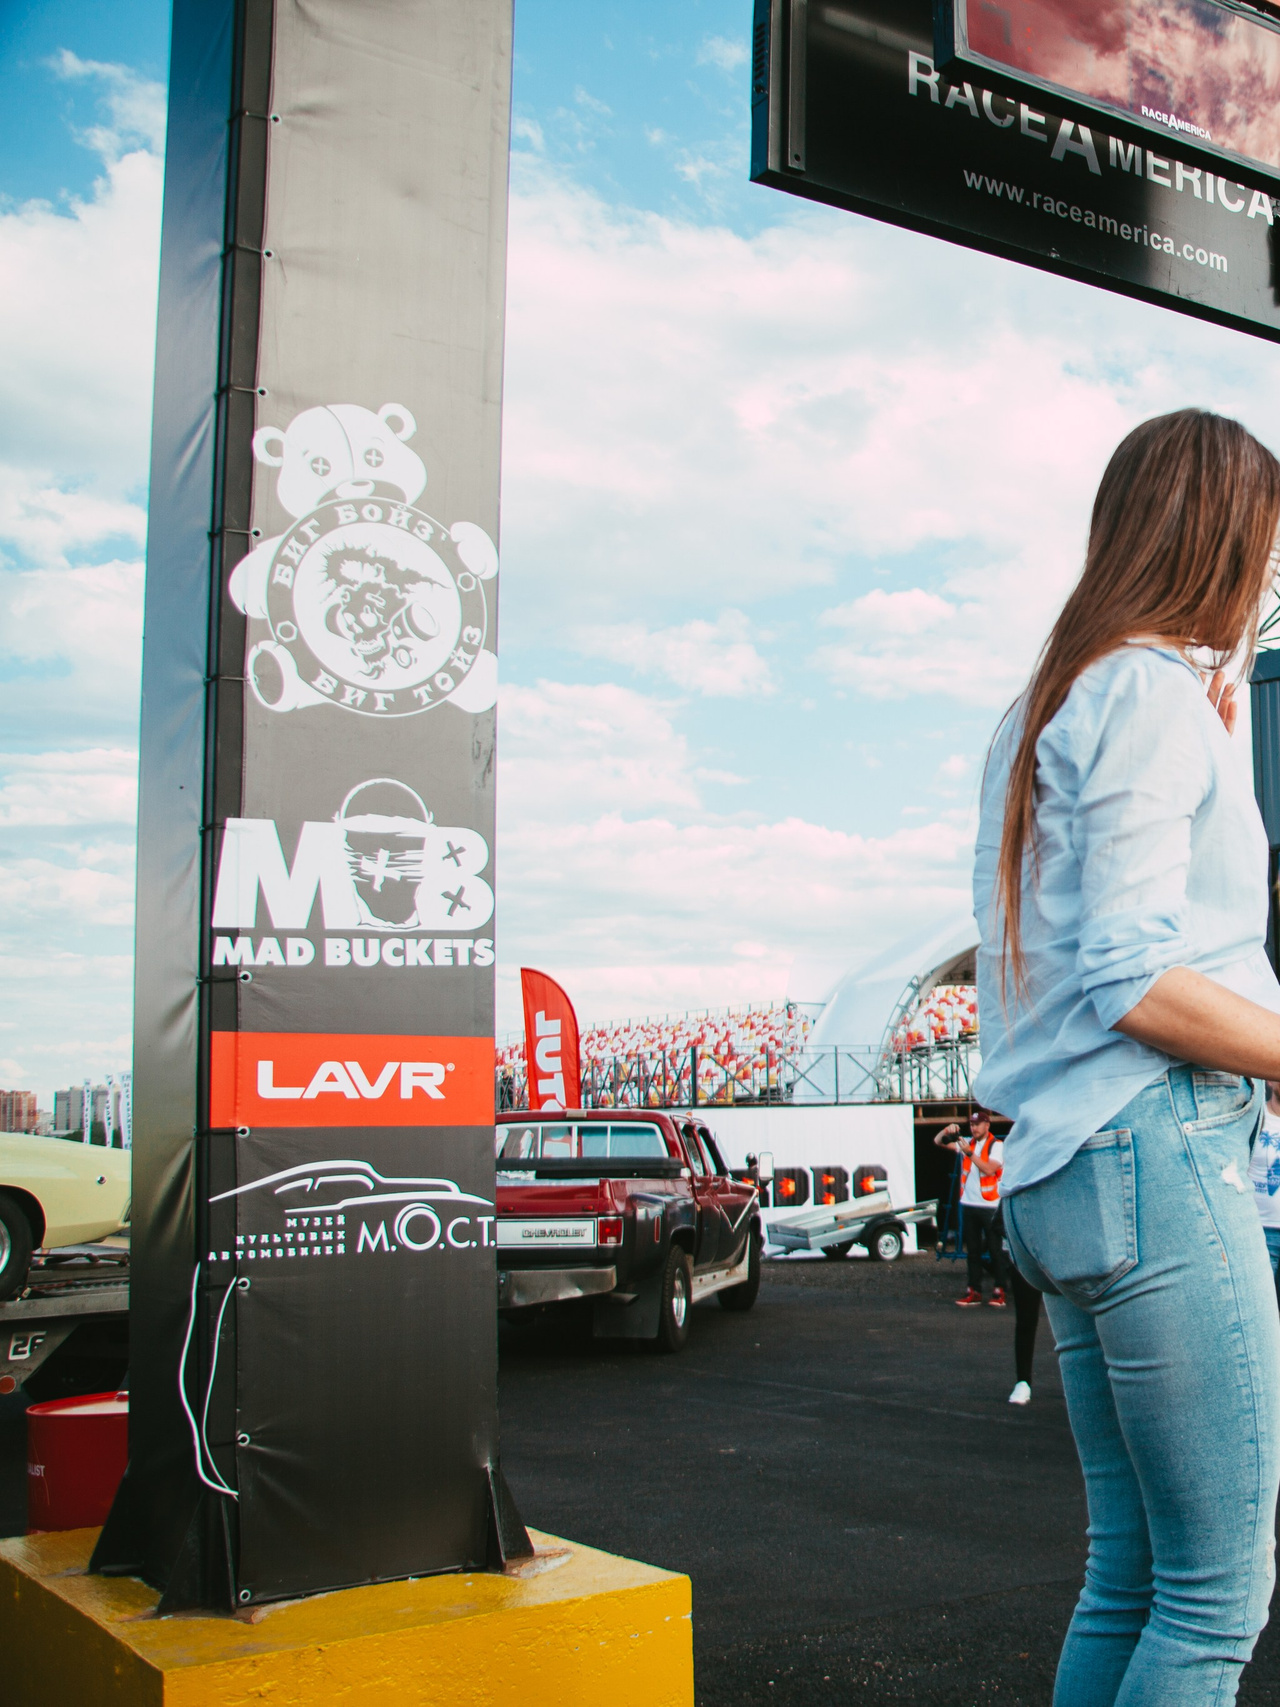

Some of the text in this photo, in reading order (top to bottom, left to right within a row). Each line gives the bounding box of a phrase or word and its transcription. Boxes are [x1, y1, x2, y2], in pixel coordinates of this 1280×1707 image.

[1141, 105, 1212, 141] RACEAMERICA
[963, 168, 1229, 274] www.raceamerica.com
[273, 518, 322, 589] БИГ
[311, 668, 395, 712] БИГ
[213, 936, 496, 967] MAD BUCKETS
[286, 1214, 346, 1228] МУЗЕЙ
[522, 1228, 587, 1238] CHEVROLET
[208, 1245, 346, 1262] АВТОМОБИЛЕЙ
[236, 1230, 346, 1246] КУЛЬТОВЫХ
